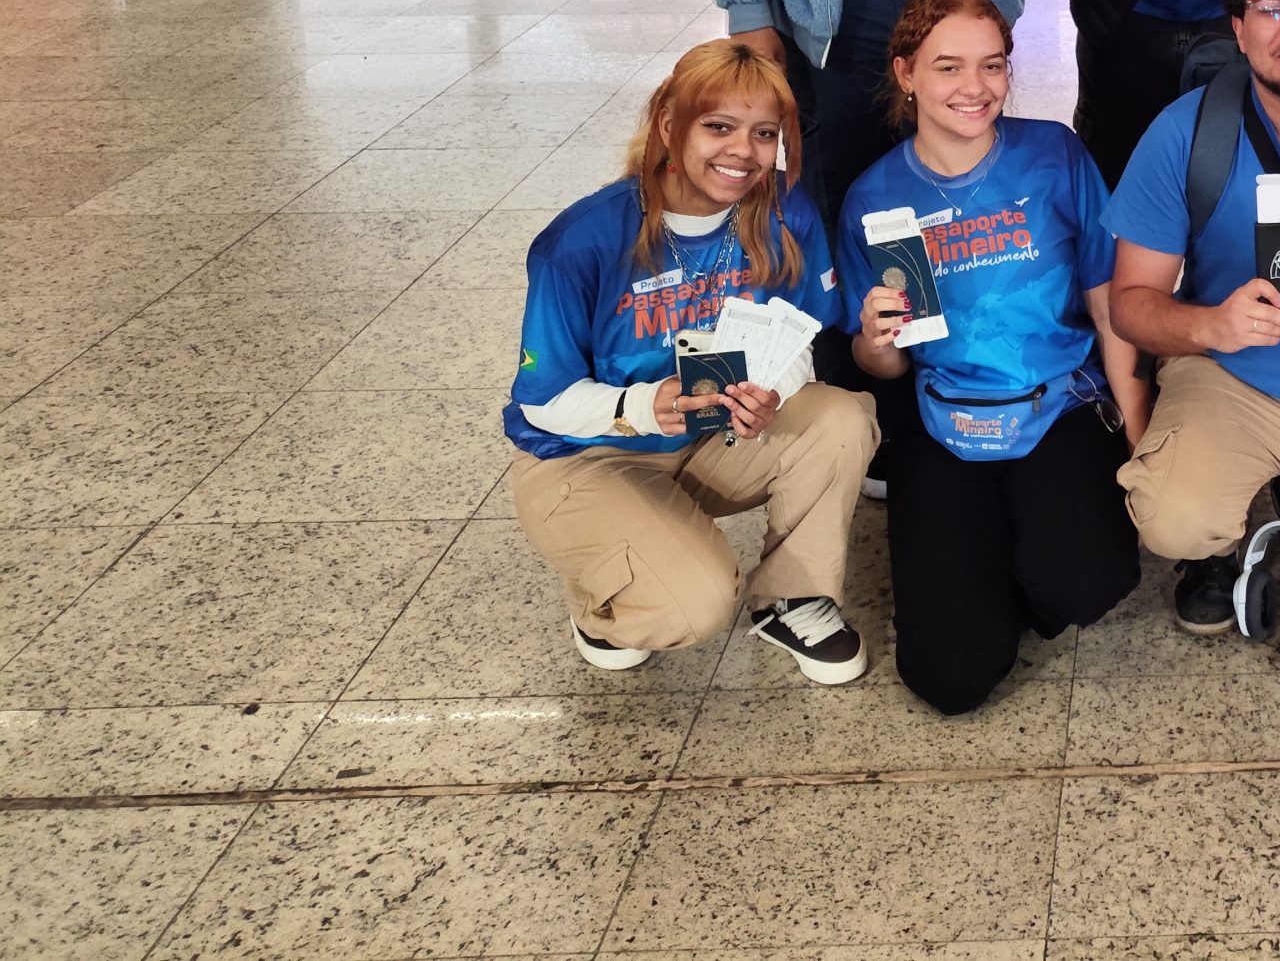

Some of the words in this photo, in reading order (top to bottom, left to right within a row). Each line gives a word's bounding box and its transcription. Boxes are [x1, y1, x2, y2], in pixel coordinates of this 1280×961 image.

[918, 215, 946, 227] rojeto
[934, 260, 949, 277] do
[953, 241, 1040, 273] conhecimento
